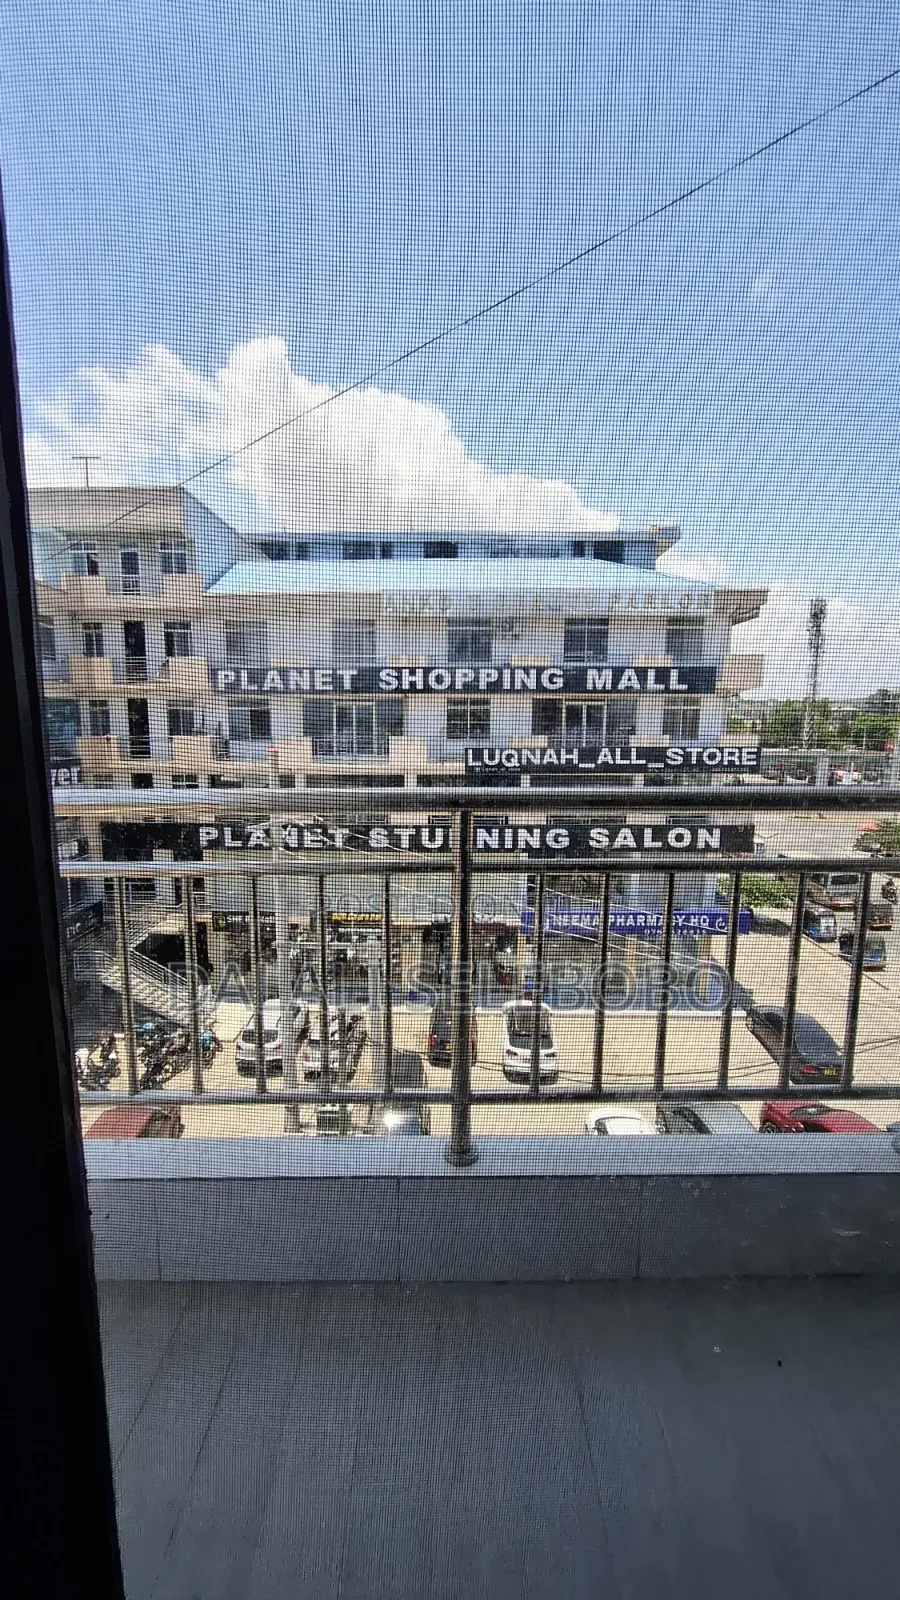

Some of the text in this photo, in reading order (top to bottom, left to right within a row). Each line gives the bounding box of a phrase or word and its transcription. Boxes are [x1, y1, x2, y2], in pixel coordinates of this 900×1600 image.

[217, 667, 688, 692] PLANET SHOPPING MALL
[466, 747, 758, 768] LUQNAH_ALL_STORE
[368, 827, 571, 850] STUNING
[588, 827, 722, 850] SALON
[608, 914, 686, 927] PHARMAY
